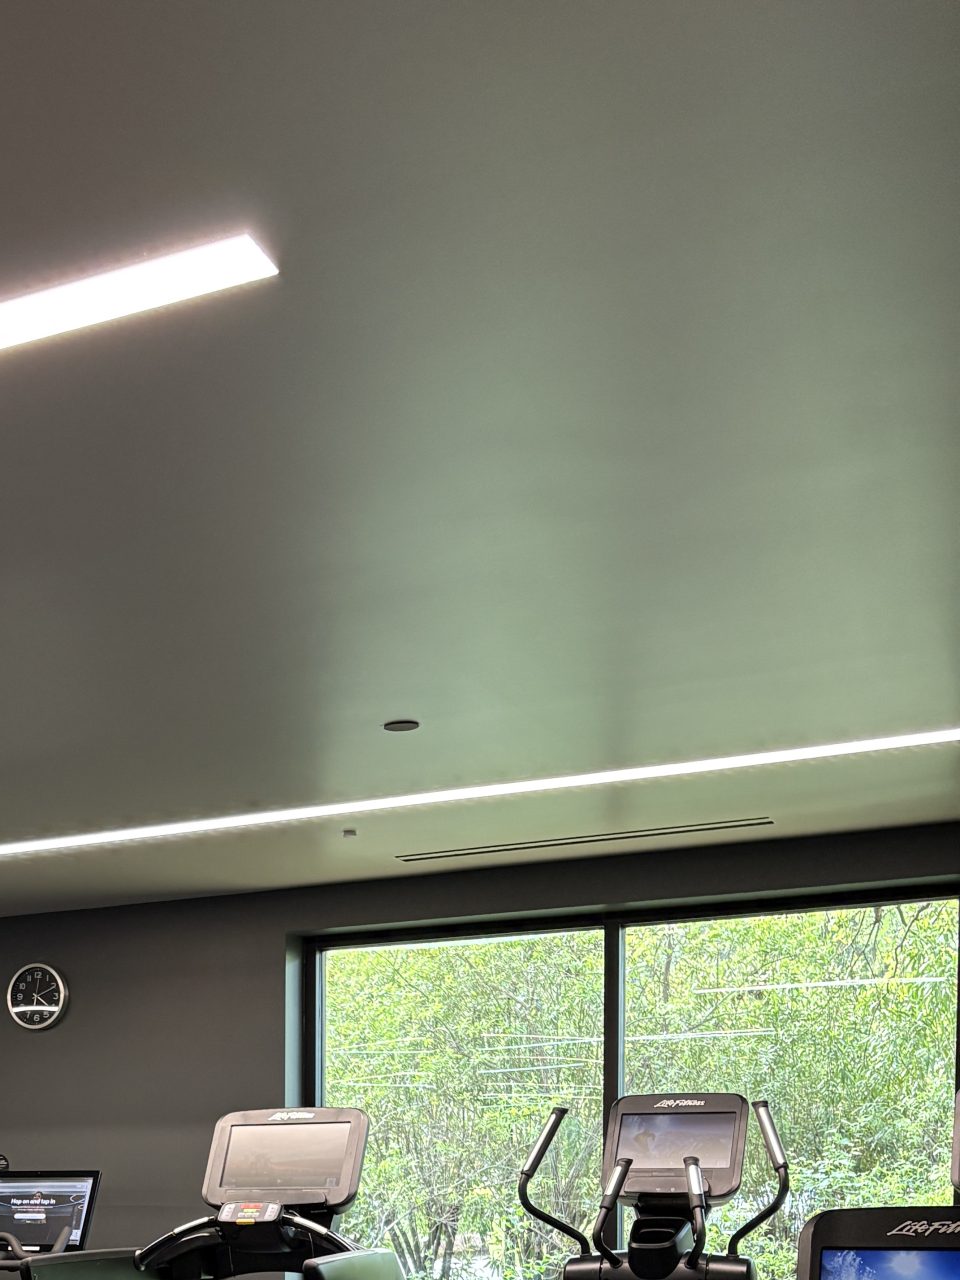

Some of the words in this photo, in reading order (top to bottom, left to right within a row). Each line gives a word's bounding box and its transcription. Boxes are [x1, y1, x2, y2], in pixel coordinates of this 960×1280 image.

[34, 971, 42, 979] 12
[16, 993, 23, 1001] 9
[33, 1014, 40, 1022] 6
[886, 1220, 929, 1236] Life
